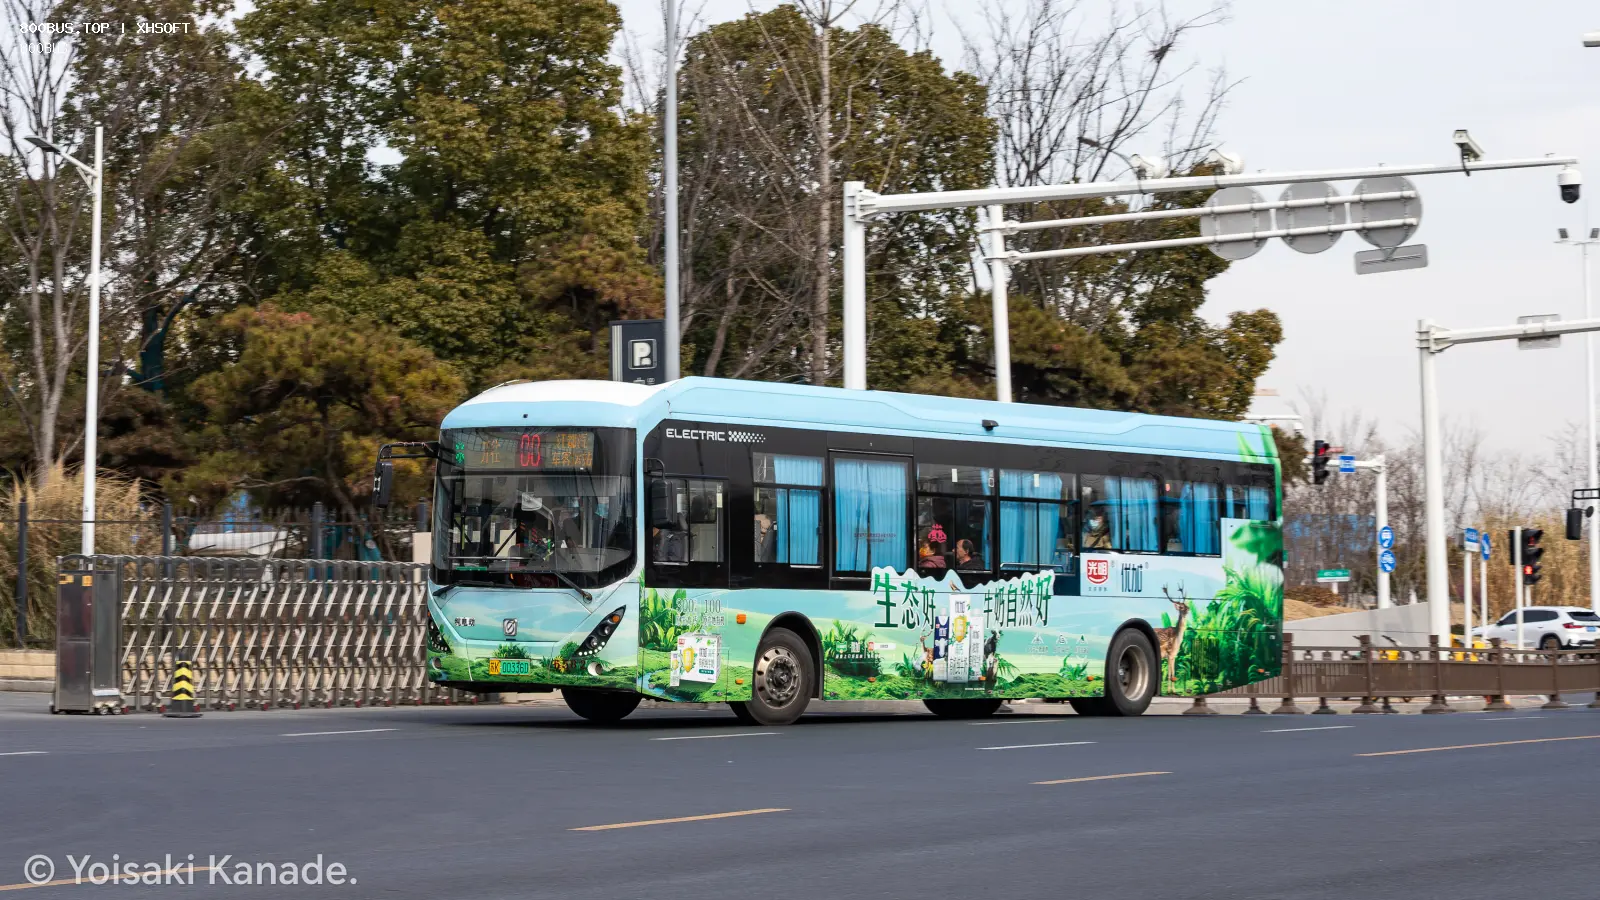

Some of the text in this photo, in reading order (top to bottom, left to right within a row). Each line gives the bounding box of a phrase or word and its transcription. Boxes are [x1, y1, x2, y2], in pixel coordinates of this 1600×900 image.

[666, 428, 725, 442] ELECTRIC
[1088, 561, 1107, 576] 光明
[873, 571, 1053, 629] 生态好 牛奶自然好
